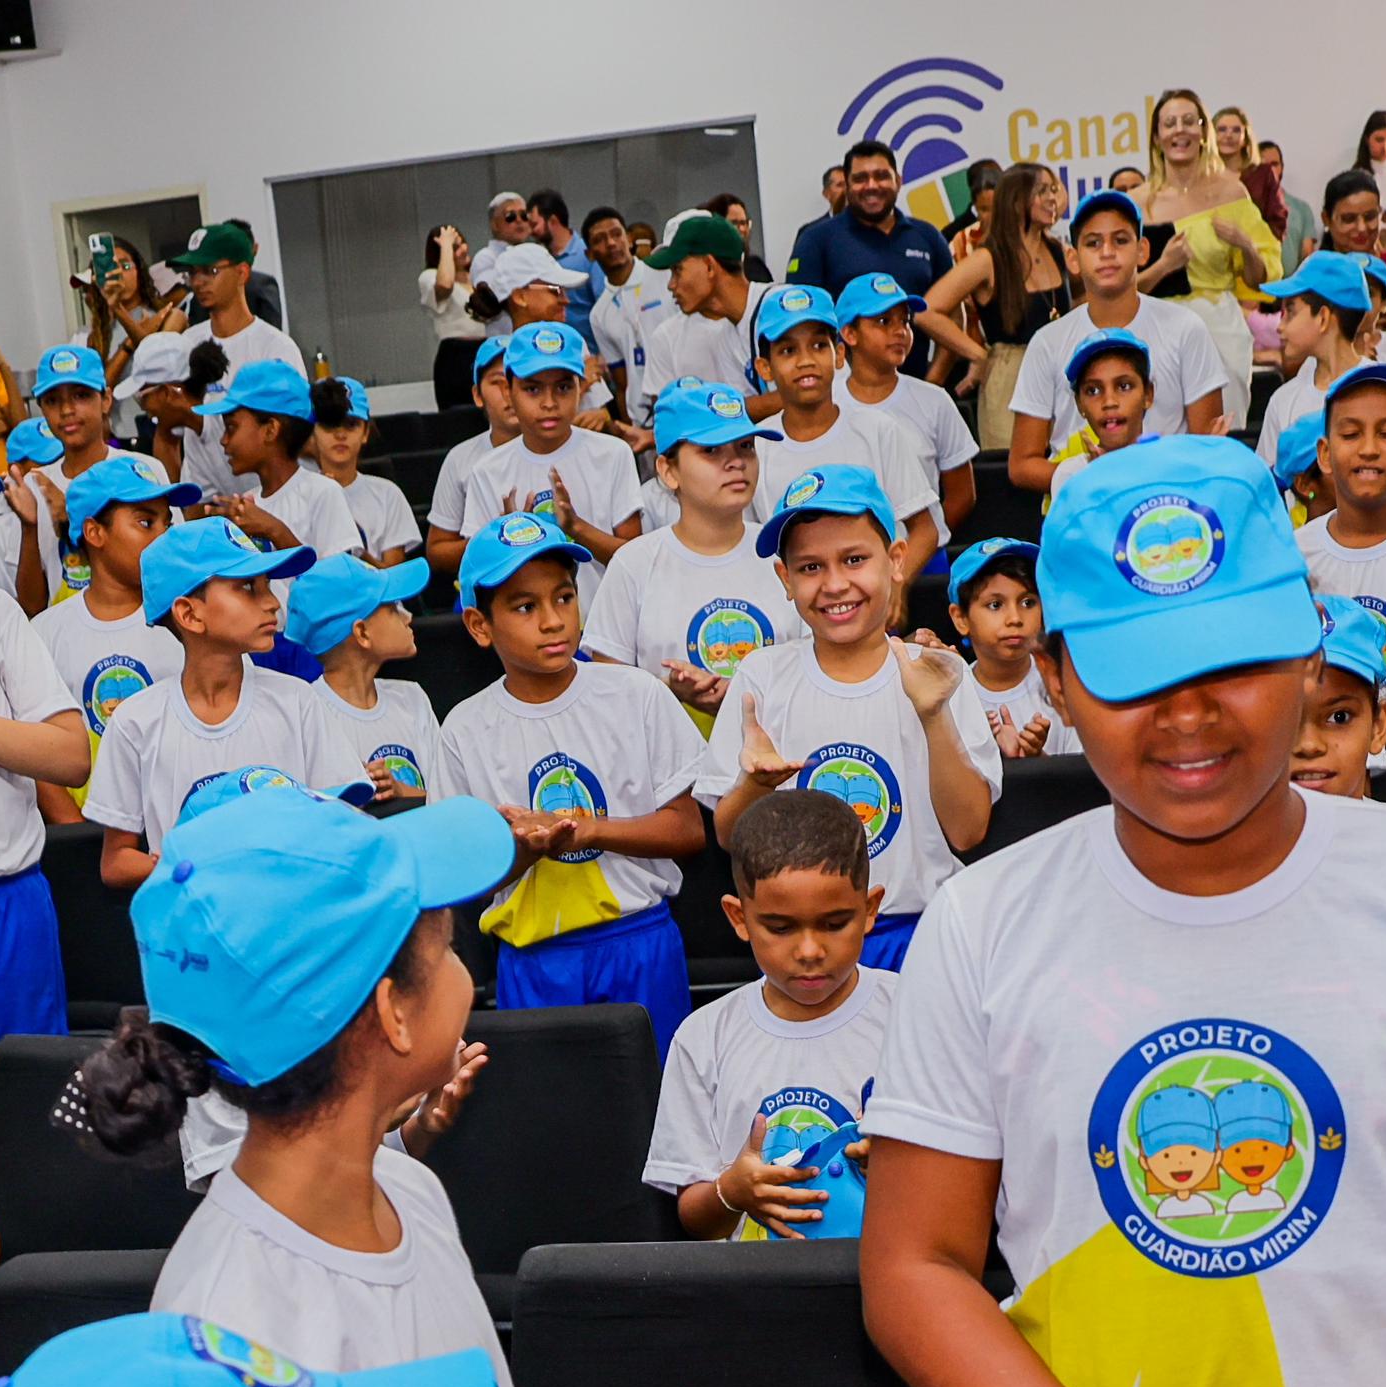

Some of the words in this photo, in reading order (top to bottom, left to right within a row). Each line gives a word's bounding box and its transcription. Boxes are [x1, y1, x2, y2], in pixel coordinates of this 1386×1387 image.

[1133, 496, 1190, 518] PROJETO
[819, 746, 876, 765] PROJETO
[868, 837, 886, 857] RIM
[1140, 1025, 1272, 1064] PROJETO
[765, 1091, 830, 1113] PROJETO
[1124, 1214, 1246, 1273] GUARDIÃO
[1250, 1206, 1318, 1267] MIRIM
